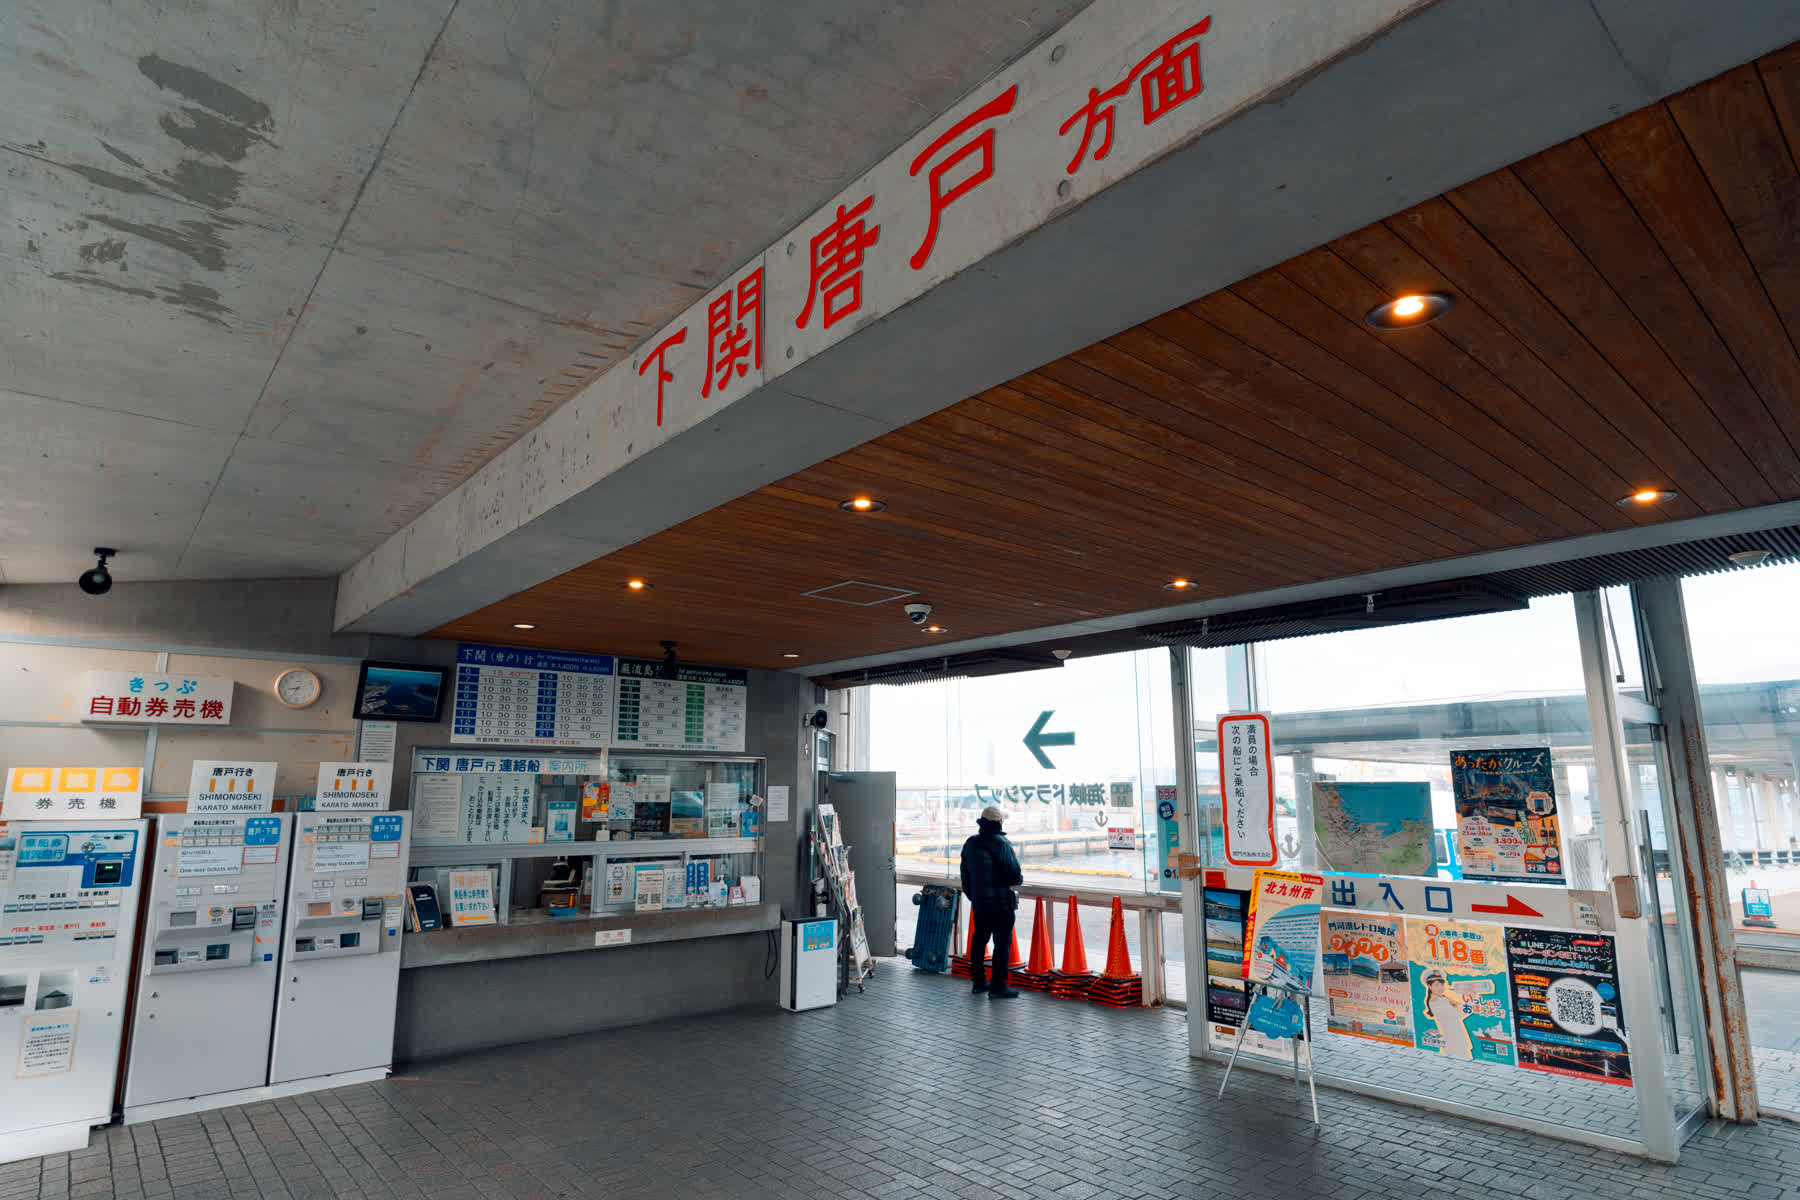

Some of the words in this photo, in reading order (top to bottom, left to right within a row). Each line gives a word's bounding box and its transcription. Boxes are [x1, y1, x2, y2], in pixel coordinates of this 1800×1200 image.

[129, 677, 197, 694] きっぷ
[90, 696, 224, 719] 自動券売機
[1246, 724, 1259, 777] 満員の場合
[422, 757, 449, 771] 下関
[549, 760, 587, 773] 案内所
[1456, 752, 1545, 770] あったかクルーズ
[213, 768, 254, 776] 唐戸行き
[336, 768, 373, 777] 唐戸行き
[1231, 725, 1246, 839] 次の船にご乗船ください
[35, 798, 116, 809] 券売機
[200, 793, 262, 801] SHIMONOSEKI
[521, 786, 529, 824] お客さまへ
[1265, 882, 1315, 900] 北九州市
[1331, 880, 1453, 914] 出入口
[1328, 922, 1396, 936] 門司港レトロ地区
[1331, 936, 1386, 960] ワイワイ
[1427, 938, 1484, 964] 118番
